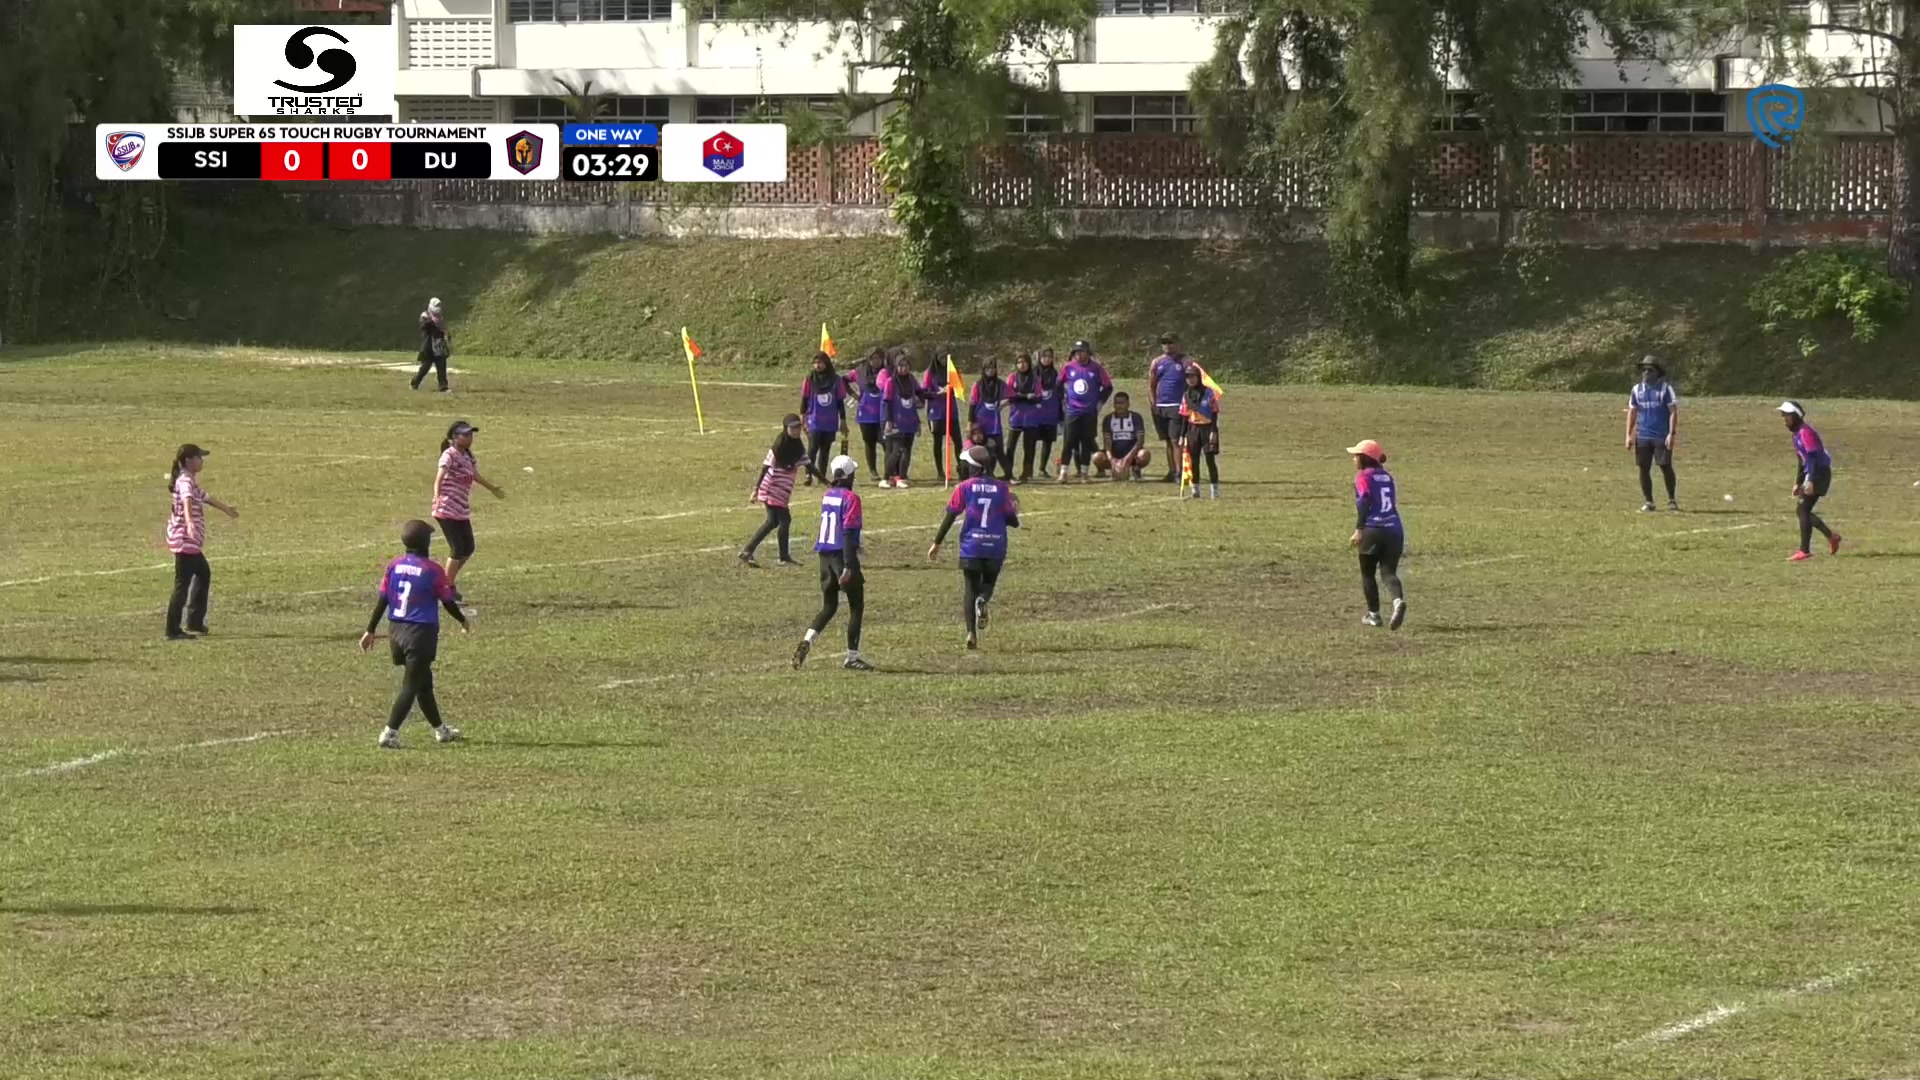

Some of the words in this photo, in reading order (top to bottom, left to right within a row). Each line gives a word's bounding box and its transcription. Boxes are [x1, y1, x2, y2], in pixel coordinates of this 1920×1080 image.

[977, 497, 993, 529] 7
[1380, 487, 1393, 513] 6
[818, 511, 837, 544] 11
[393, 580, 412, 618] 3
